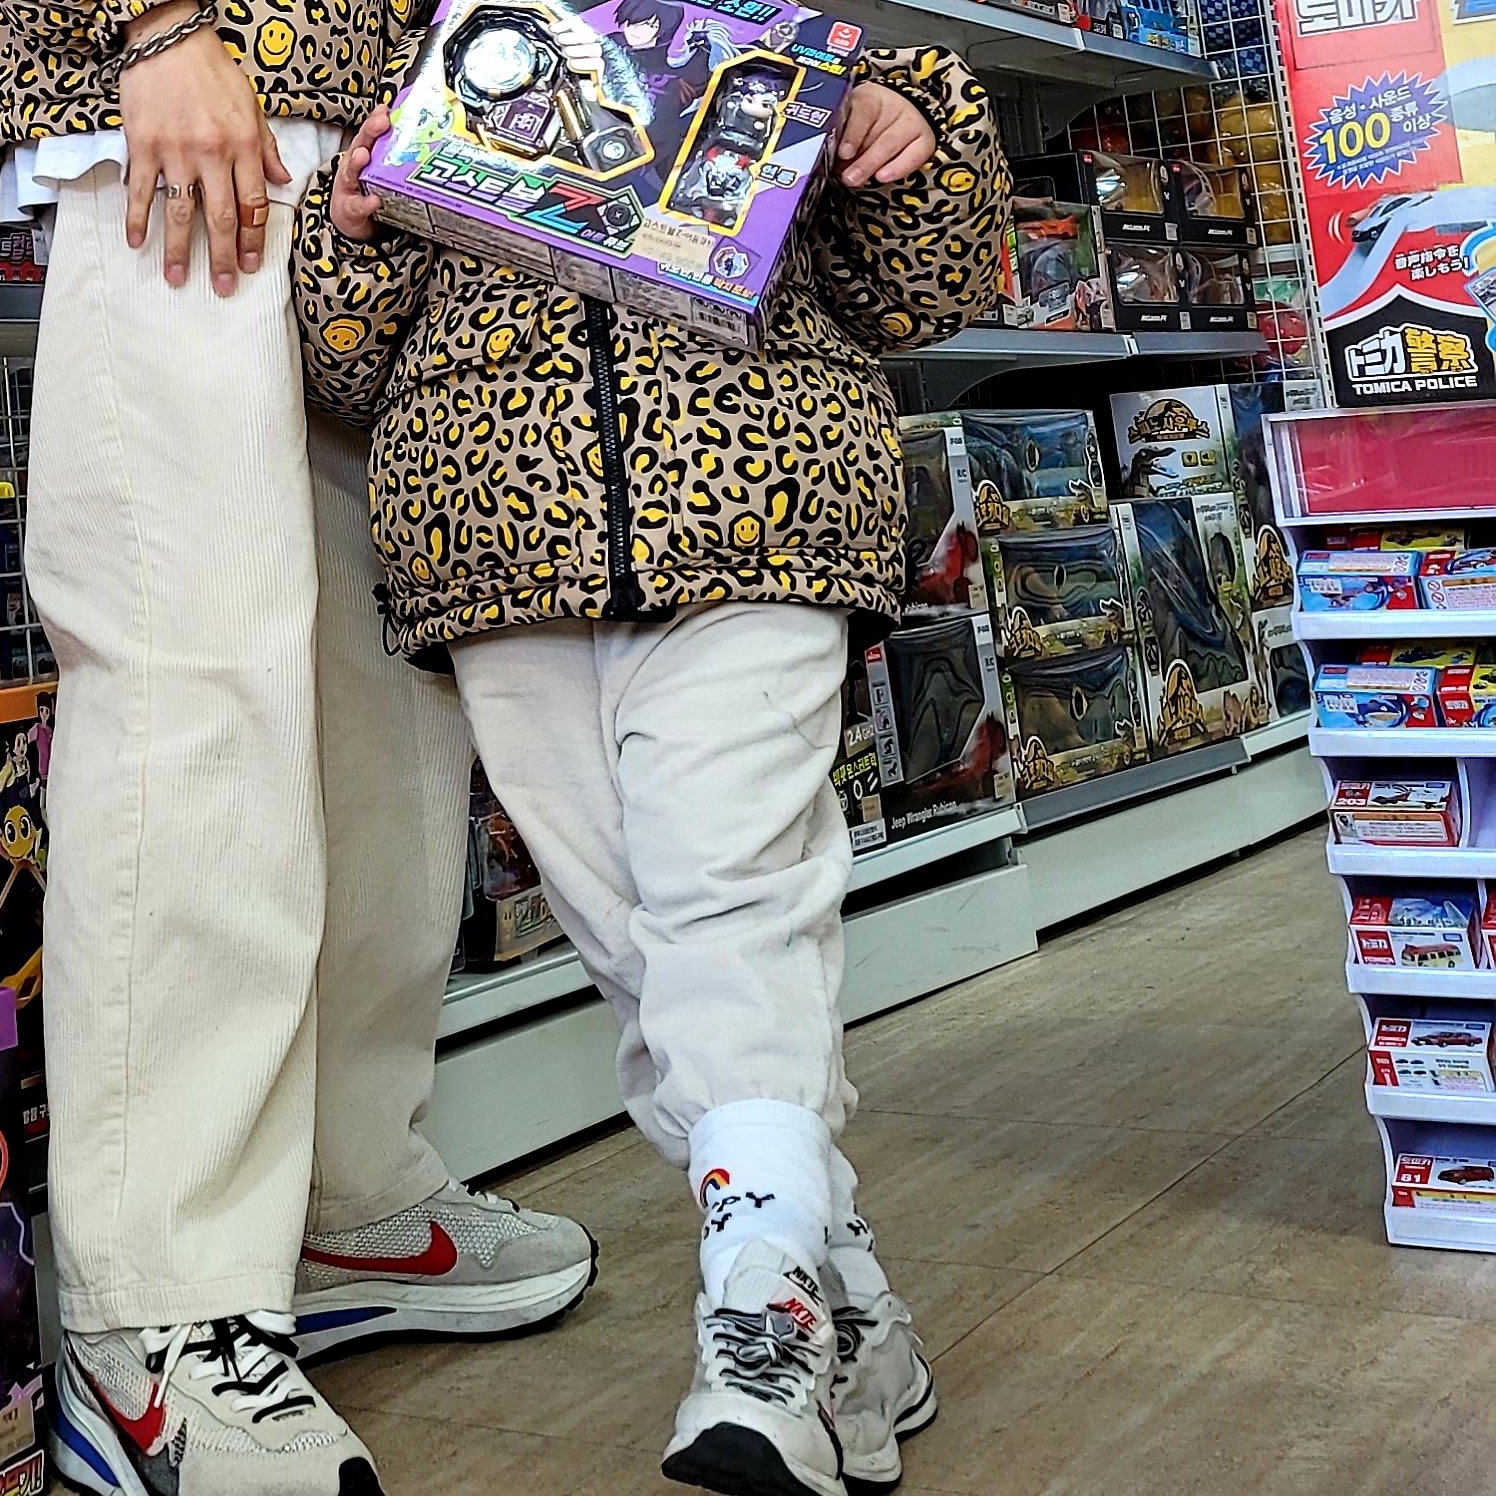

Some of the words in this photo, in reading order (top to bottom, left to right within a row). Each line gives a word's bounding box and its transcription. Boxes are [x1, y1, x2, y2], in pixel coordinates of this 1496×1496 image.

[1330, 104, 1357, 123] 음성
[1370, 87, 1411, 112] 사운드
[1391, 103, 1418, 121] 종류
[1403, 112, 1431, 133] 이상
[1320, 115, 1391, 164] 100
[1351, 327, 1475, 375] トミカ警察
[1352, 379, 1412, 395] TOMICA
[1416, 375, 1478, 391] POLICE
[1336, 797, 1365, 806] 203
[891, 816, 905, 829] Jeep
[906, 808, 933, 824] Wrangler
[933, 801, 957, 816] Rubicon
[1401, 1172, 1422, 1183] 81
